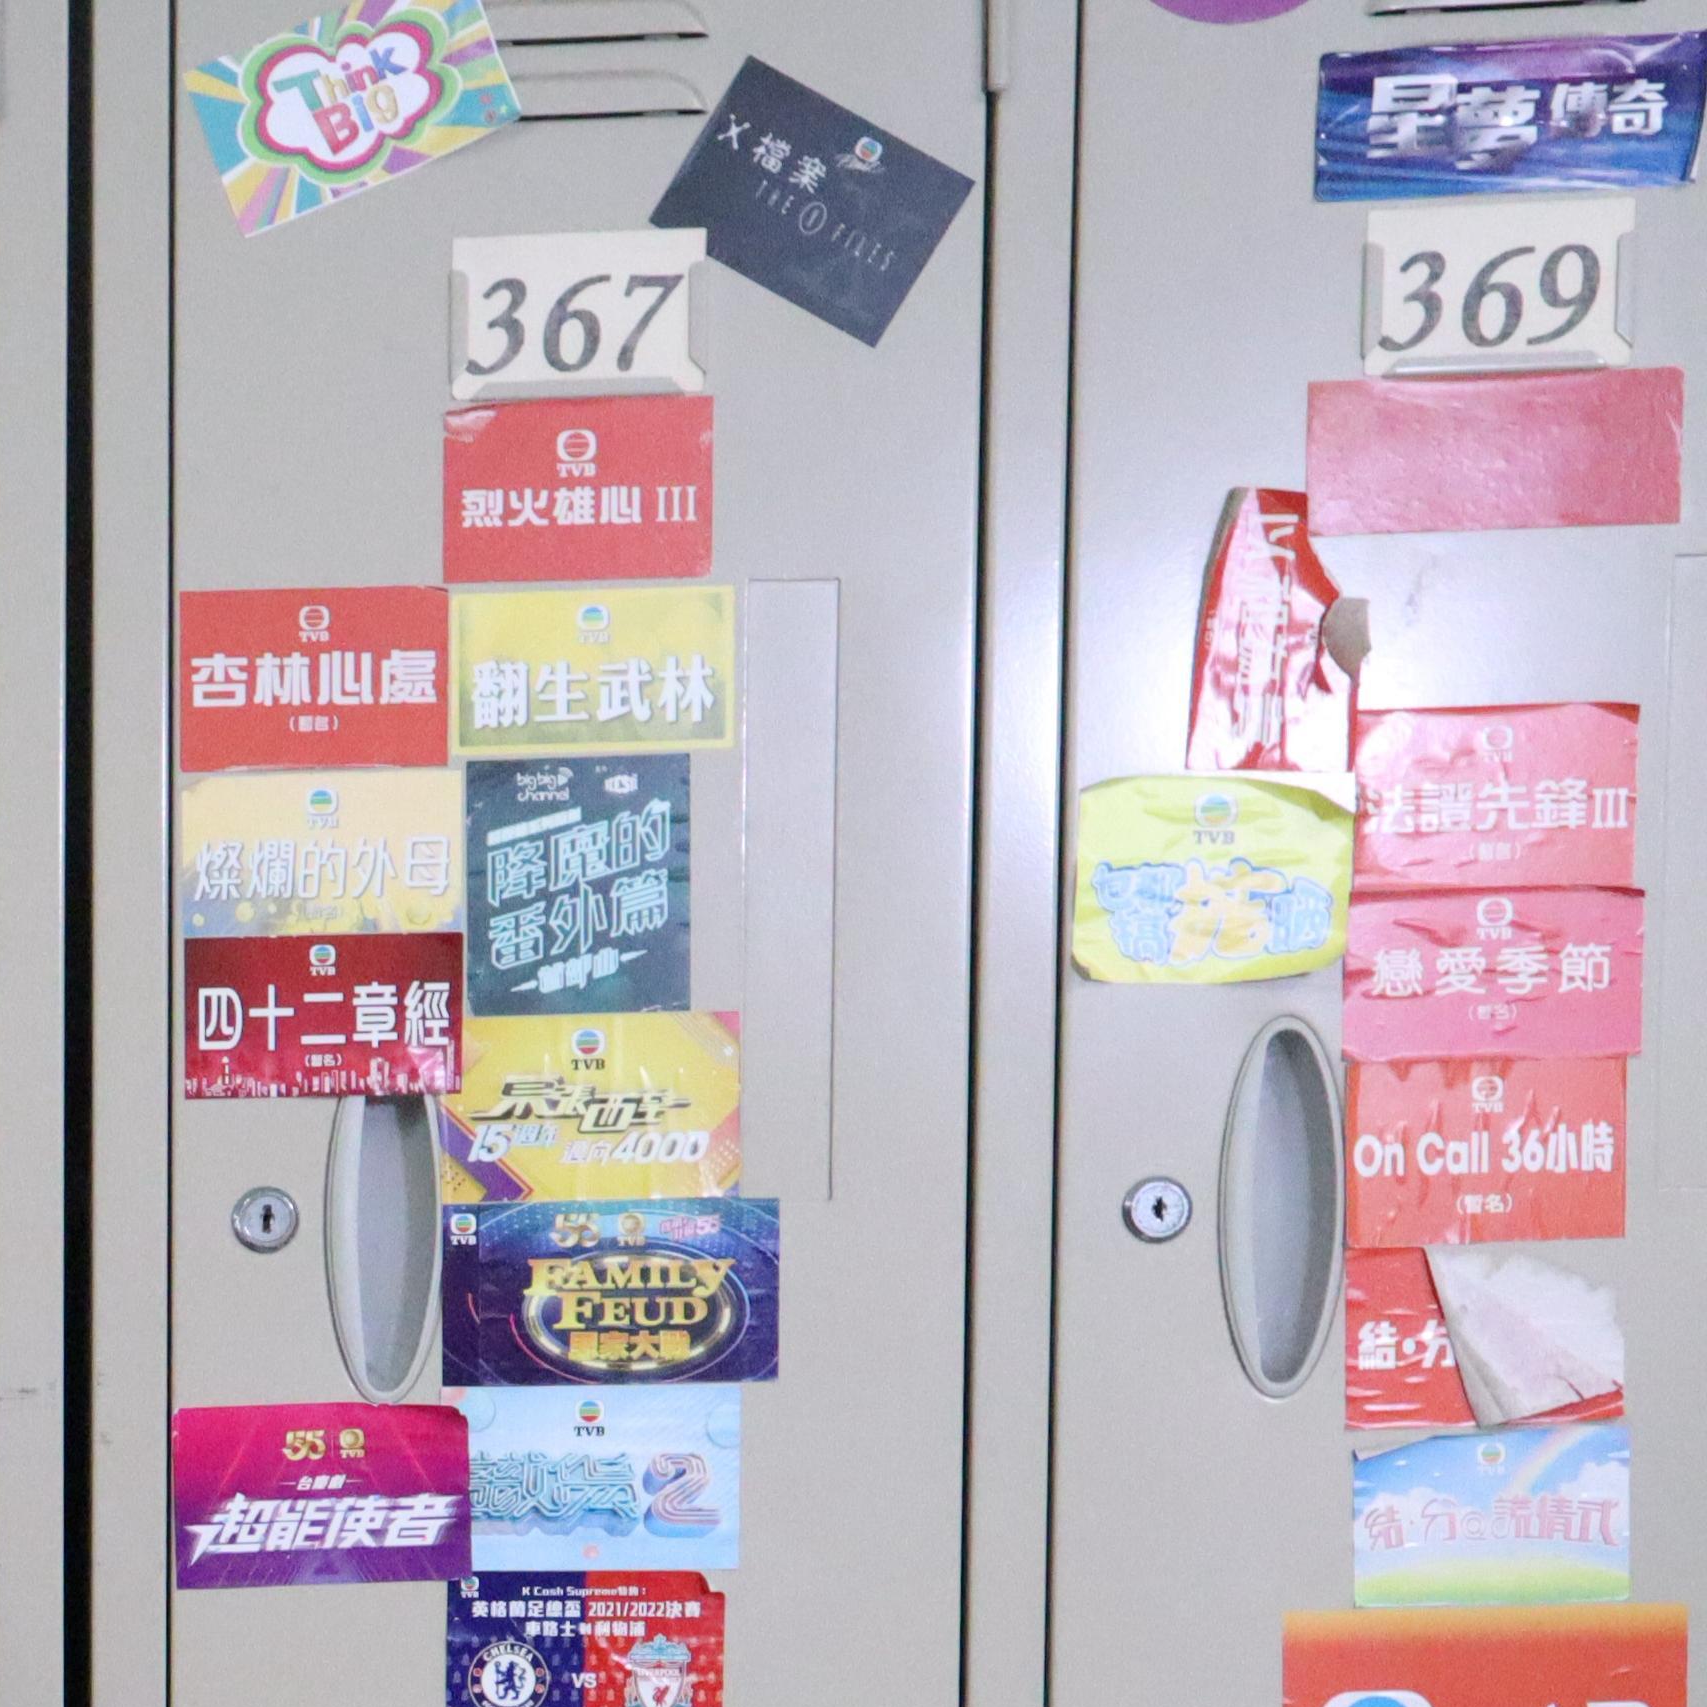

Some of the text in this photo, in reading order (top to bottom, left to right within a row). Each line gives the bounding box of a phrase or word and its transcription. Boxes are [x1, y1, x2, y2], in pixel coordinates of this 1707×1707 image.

[1367, 73, 1668, 172] 星夢傳奇
[1378, 244, 1601, 352] 369
[465, 273, 686, 376] 367
[556, 462, 597, 477] TVB
[460, 486, 642, 528] 烈火雄心
[298, 630, 330, 642] TVB
[577, 631, 610, 643] TVB
[191, 649, 437, 708] 杏林心處
[471, 653, 716, 729] 翻生武林
[517, 788, 570, 801] channel
[1193, 830, 1235, 845] TVB
[195, 834, 451, 902] 燦爛的外母
[1477, 927, 1513, 940] TVB
[309, 965, 336, 977] TVB
[1372, 943, 1612, 997] 戀愛季節
[196, 981, 451, 1052] 四十二章經
[571, 1059, 606, 1071] TVB
[1472, 1103, 1503, 1113] TVB
[1353, 1122, 1615, 1178] On Call 36小時
[450, 1236, 477, 1246] TVB
[618, 1236, 645, 1247] TVB
[553, 1290, 708, 1329] FEUD
[574, 1426, 605, 1437] TVB
[282, 1430, 326, 1461] 55
[339, 1448, 366, 1459] TVB
[183, 1493, 464, 1567] 超能使者
[483, 1643, 534, 1662] CHELSEA
[572, 1674, 597, 1688] VS
